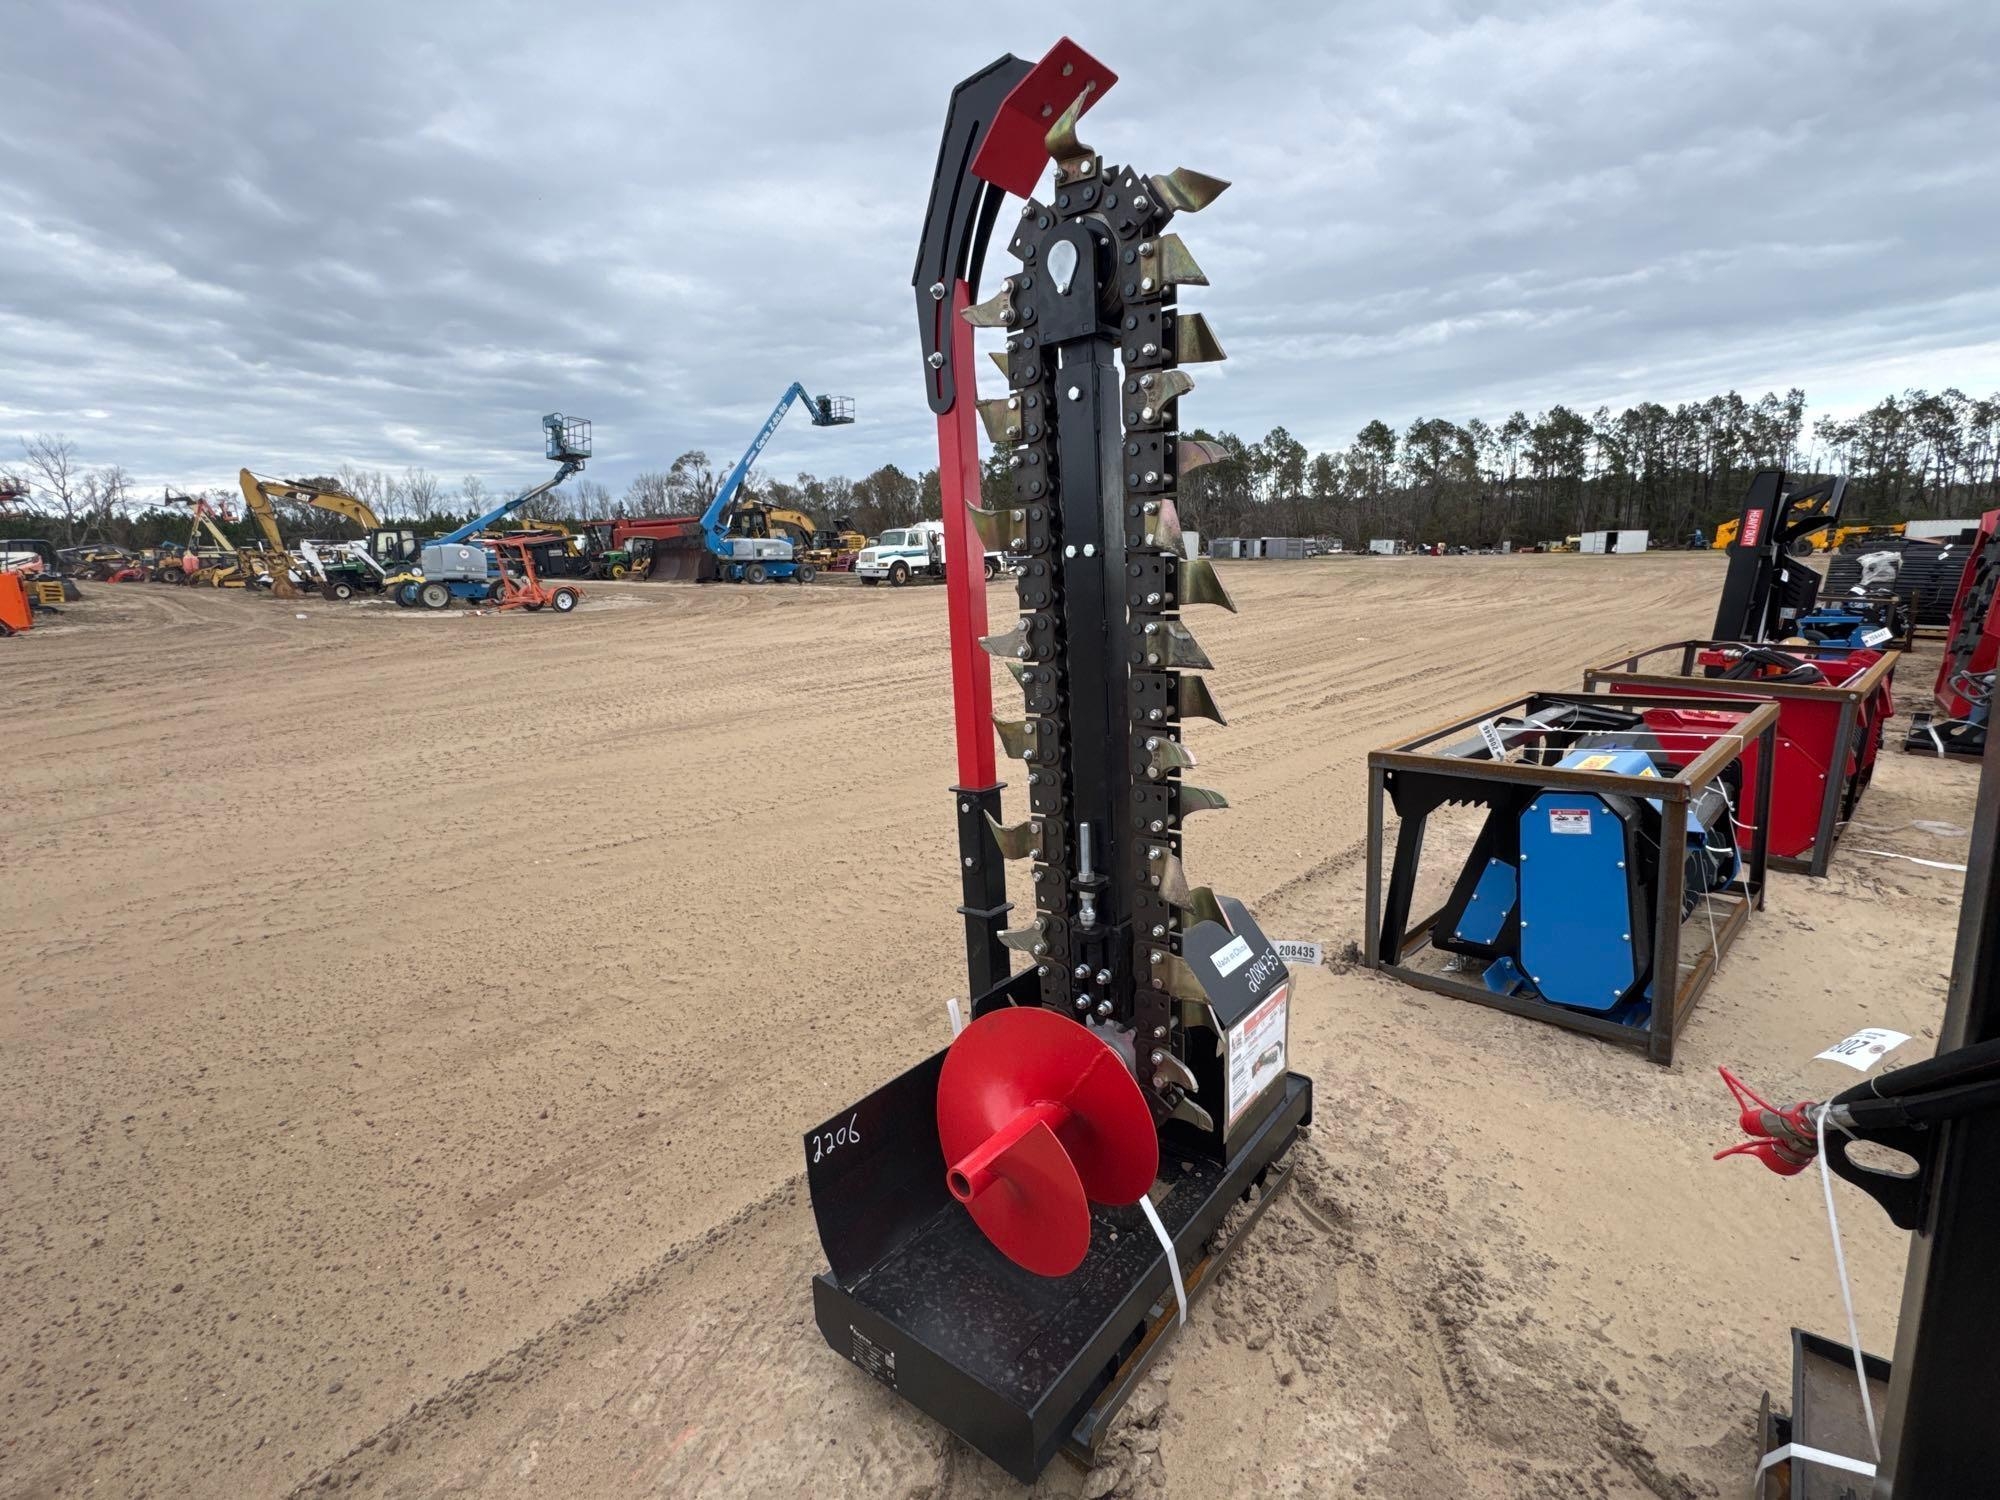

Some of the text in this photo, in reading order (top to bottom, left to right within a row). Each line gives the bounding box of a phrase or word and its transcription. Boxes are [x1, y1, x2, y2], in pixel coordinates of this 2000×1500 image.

[296, 492, 311, 502] CAT
[1743, 509, 1761, 546] HEAVY DUTY
[1245, 947, 1279, 993] 208435
[1279, 945, 1315, 958] 208435
[812, 1112, 860, 1164] 2206
